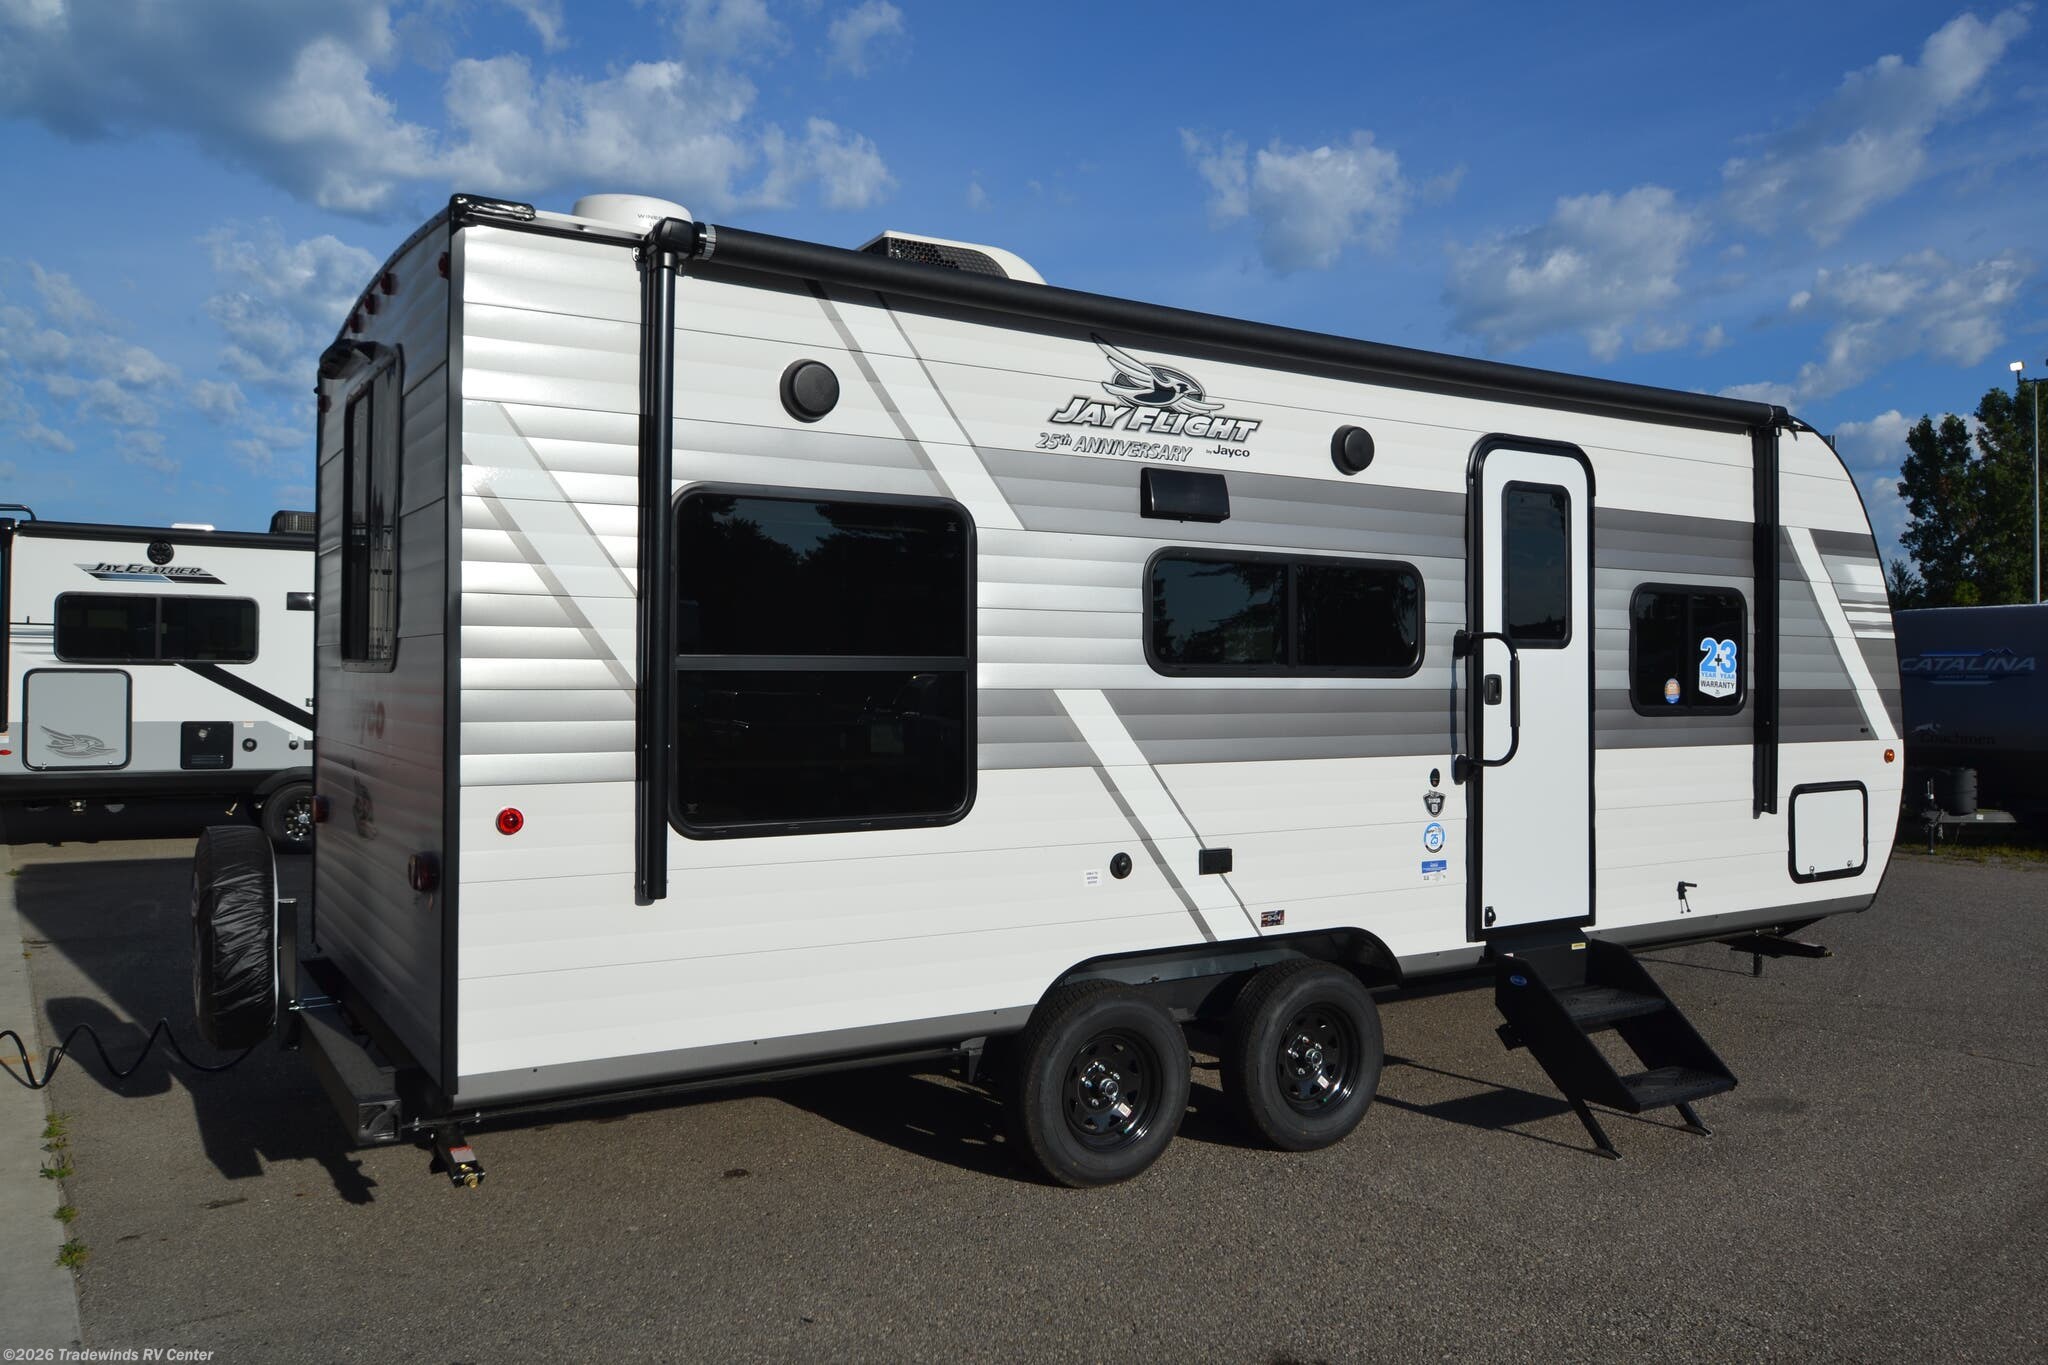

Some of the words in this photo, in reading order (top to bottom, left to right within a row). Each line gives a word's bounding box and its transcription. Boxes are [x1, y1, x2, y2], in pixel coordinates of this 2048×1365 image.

[1048, 394, 1134, 428] JAY
[1123, 405, 1263, 443] FLIGHT
[1035, 432, 1072, 451] 25th
[1072, 435, 1193, 463] ANNIVERSARY
[1213, 444, 1251, 458] Jayco
[93, 562, 123, 573] JAY
[125, 563, 201, 575] FEATHER
[1900, 656, 2036, 671] CATALINA
[1700, 680, 1735, 689] WARRANTY
